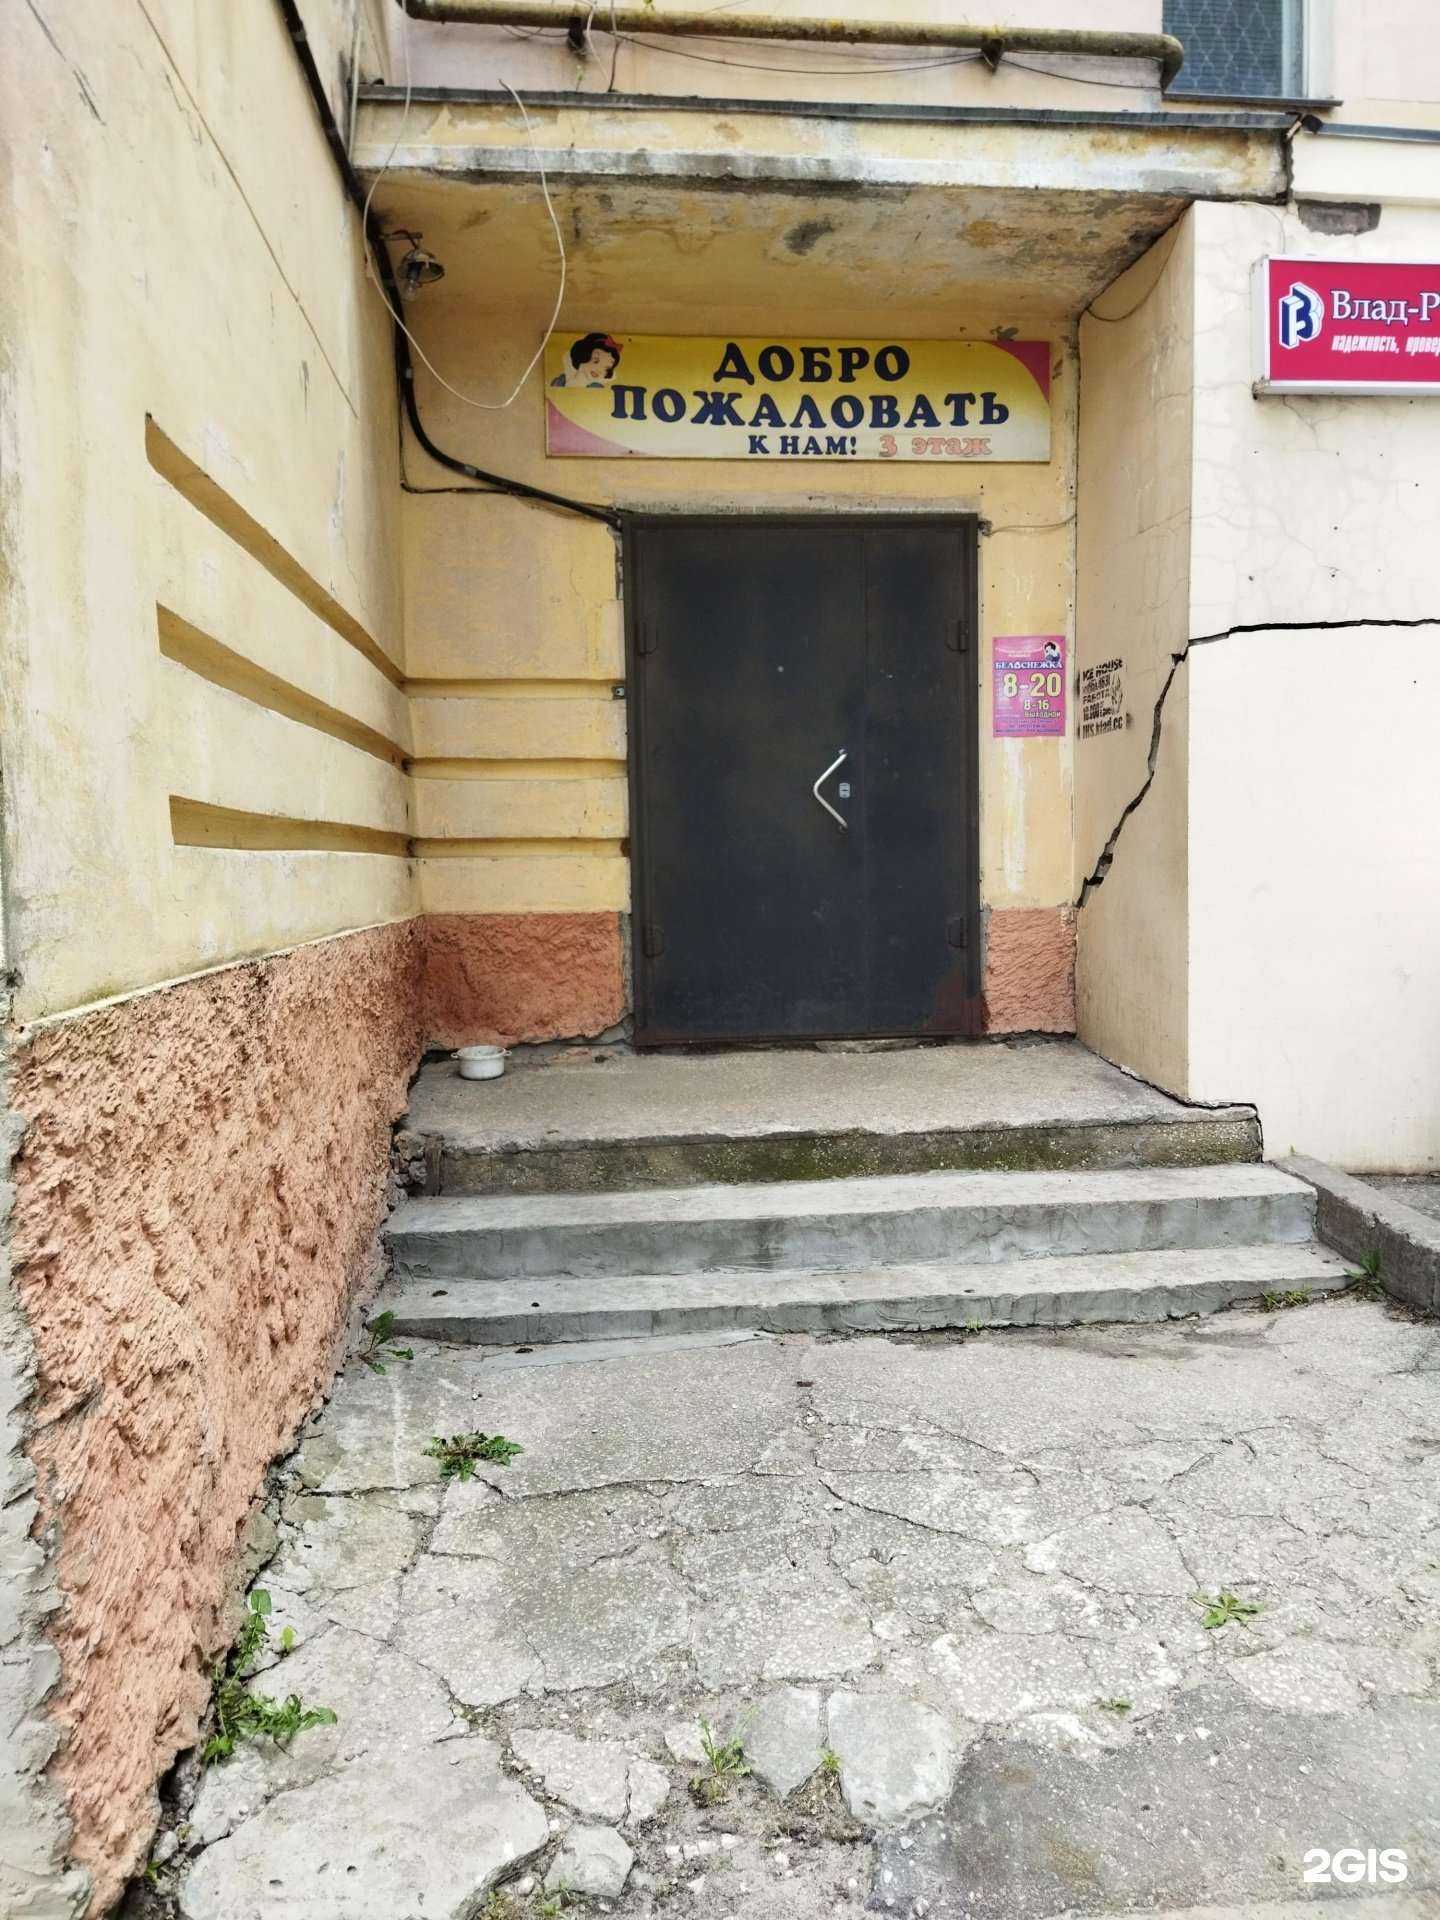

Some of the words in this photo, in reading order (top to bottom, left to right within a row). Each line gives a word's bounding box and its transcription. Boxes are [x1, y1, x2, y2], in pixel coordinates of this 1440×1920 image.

[713, 343, 911, 385] ДОБРО
[611, 385, 1010, 428] ПОЖАЛОВАТЬ
[748, 435, 770, 455] К
[779, 435, 857, 455] НАМ!
[878, 434, 898, 457] 3
[911, 437, 992, 457] этаж
[1003, 672, 1062, 698] 8-20
